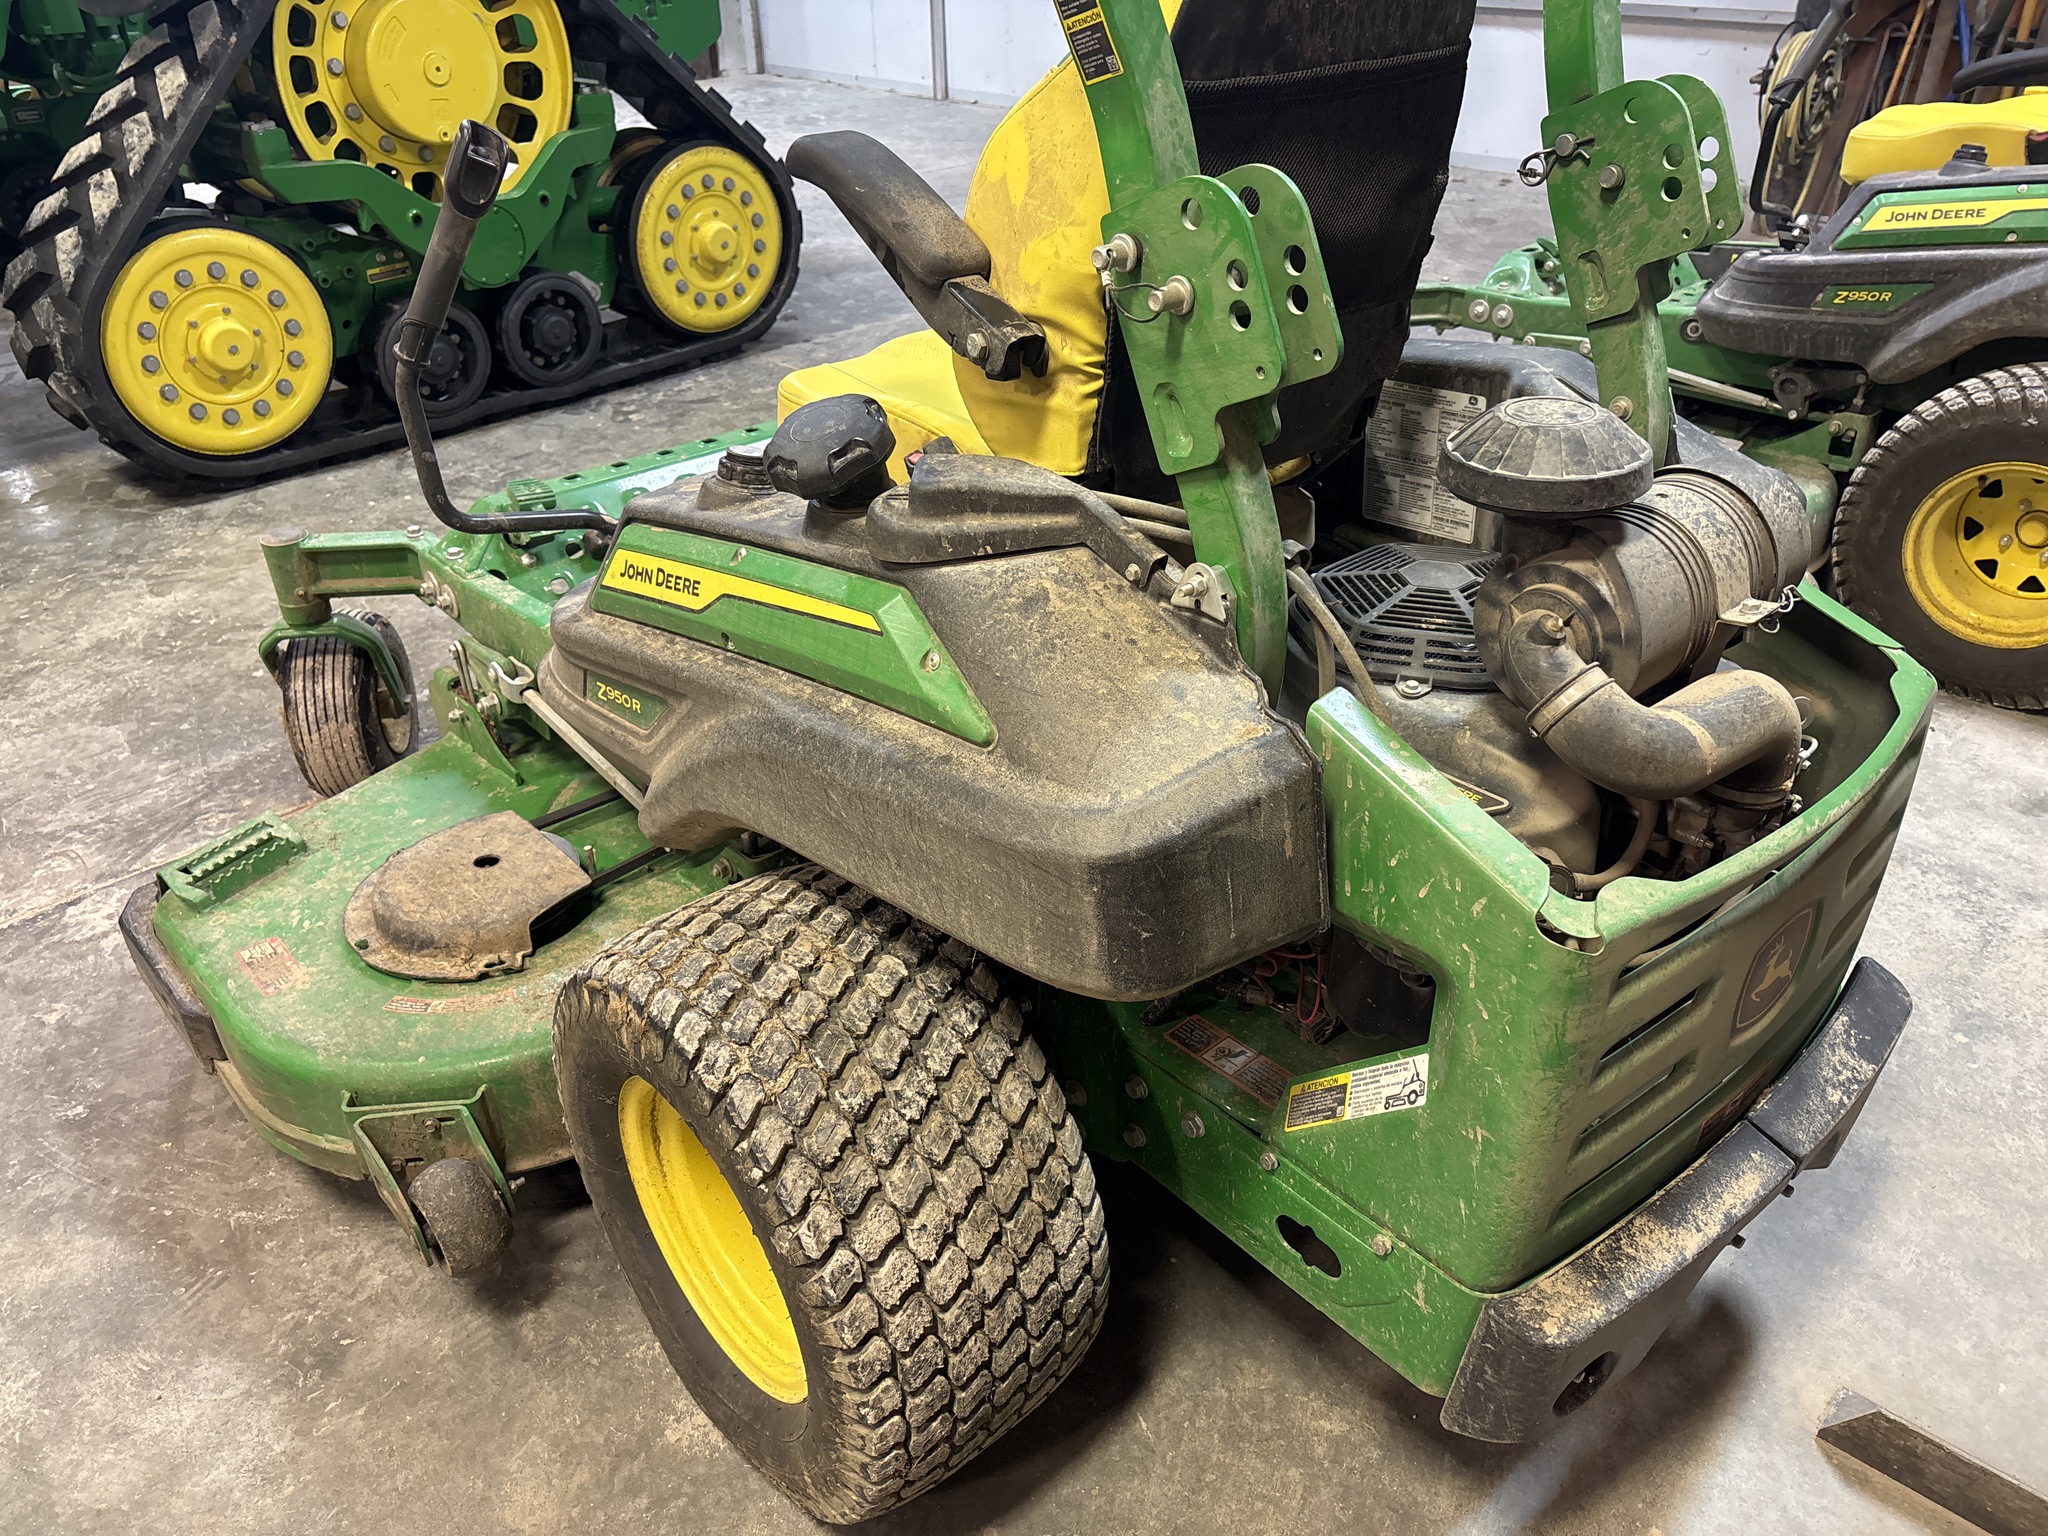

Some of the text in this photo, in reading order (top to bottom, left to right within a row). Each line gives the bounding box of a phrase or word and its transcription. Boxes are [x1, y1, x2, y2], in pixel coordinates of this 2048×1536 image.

[1072, 10, 1102, 28] ATENCIÓN
[1885, 208, 1986, 222] JOHN DEERE
[1832, 291, 1892, 304] Z950R
[620, 560, 701, 597] JOHN DEERE
[596, 681, 641, 714] Z950R
